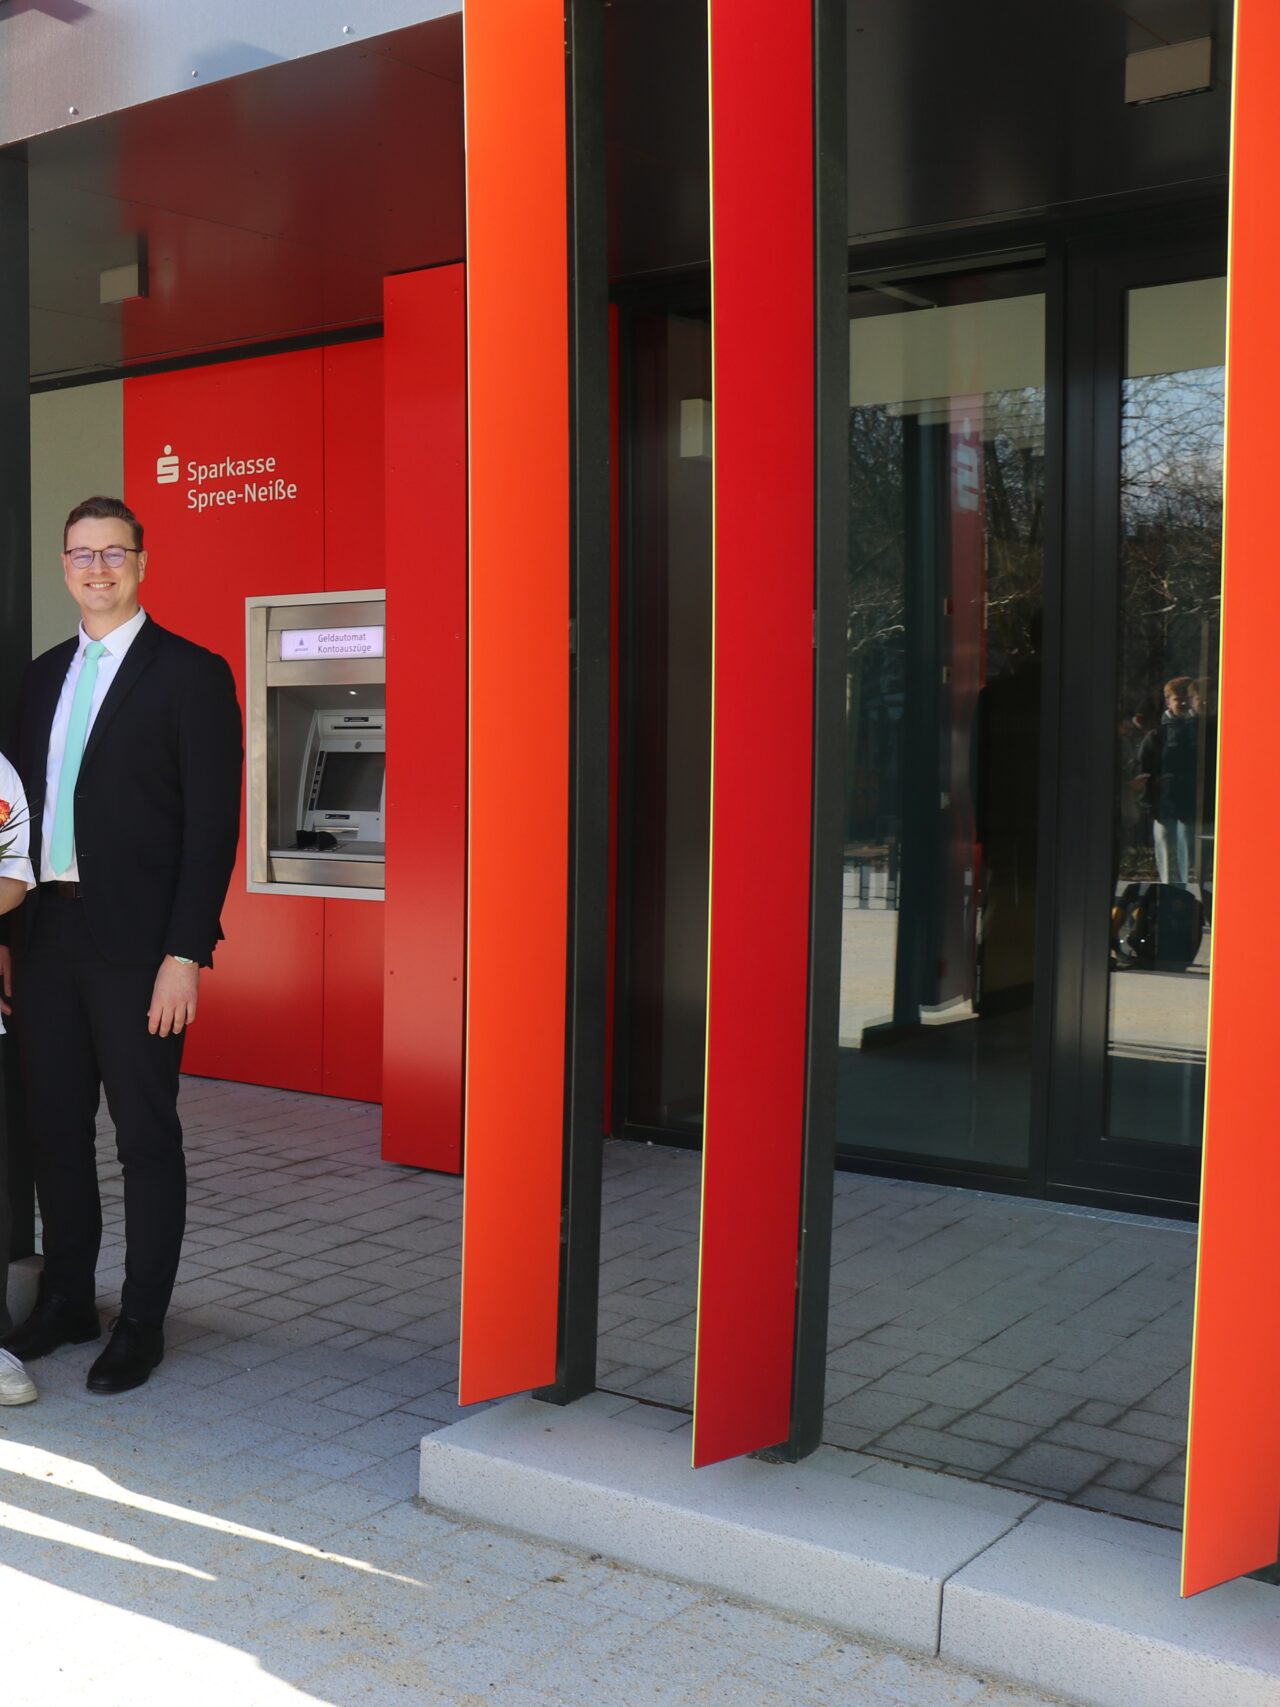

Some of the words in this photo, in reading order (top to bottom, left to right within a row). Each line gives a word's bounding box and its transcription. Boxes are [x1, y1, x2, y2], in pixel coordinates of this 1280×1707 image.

[187, 456, 276, 485] Sparkasse
[187, 478, 297, 513] Spree-Neiße
[318, 633, 366, 643] Geldautomat
[318, 644, 372, 654] Kontoauszüge
